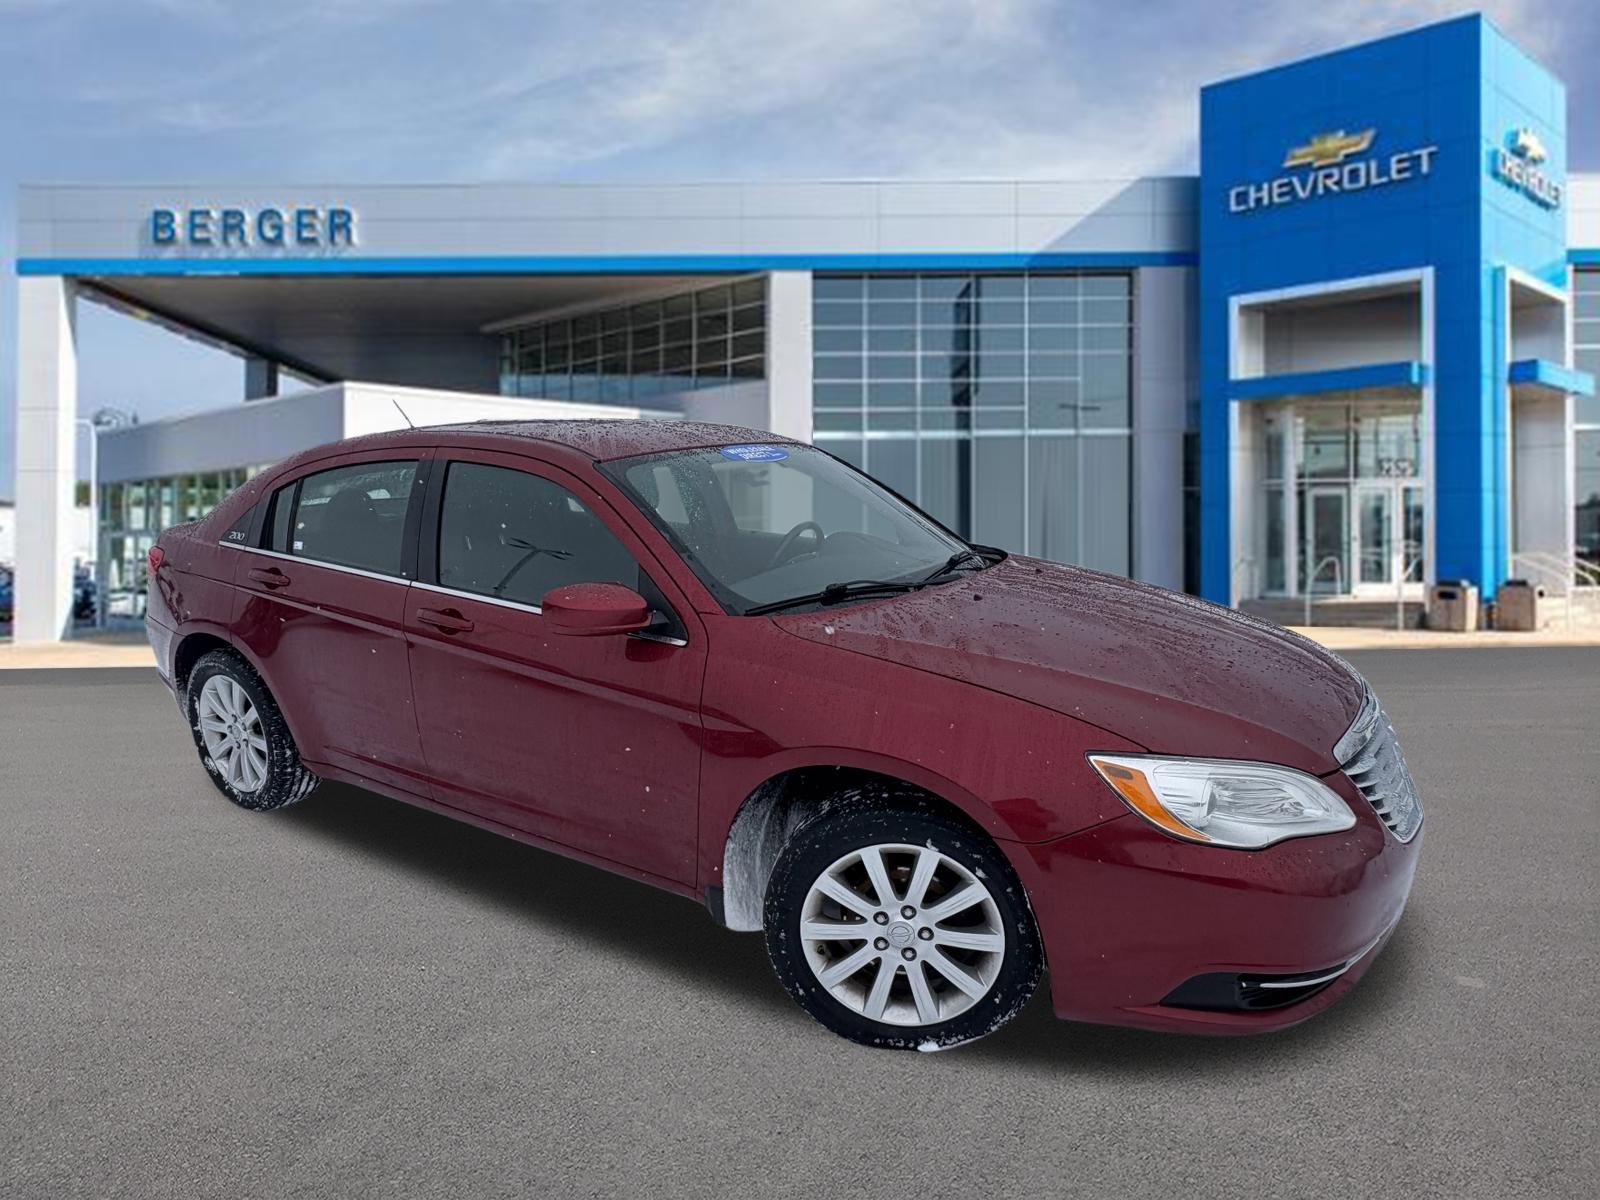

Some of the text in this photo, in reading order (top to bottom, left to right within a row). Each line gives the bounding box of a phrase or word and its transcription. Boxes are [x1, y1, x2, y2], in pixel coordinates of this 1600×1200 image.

[1229, 146, 1438, 212] CHEVROLET
[152, 208, 356, 246] BERGER
[228, 530, 246, 541] 200
